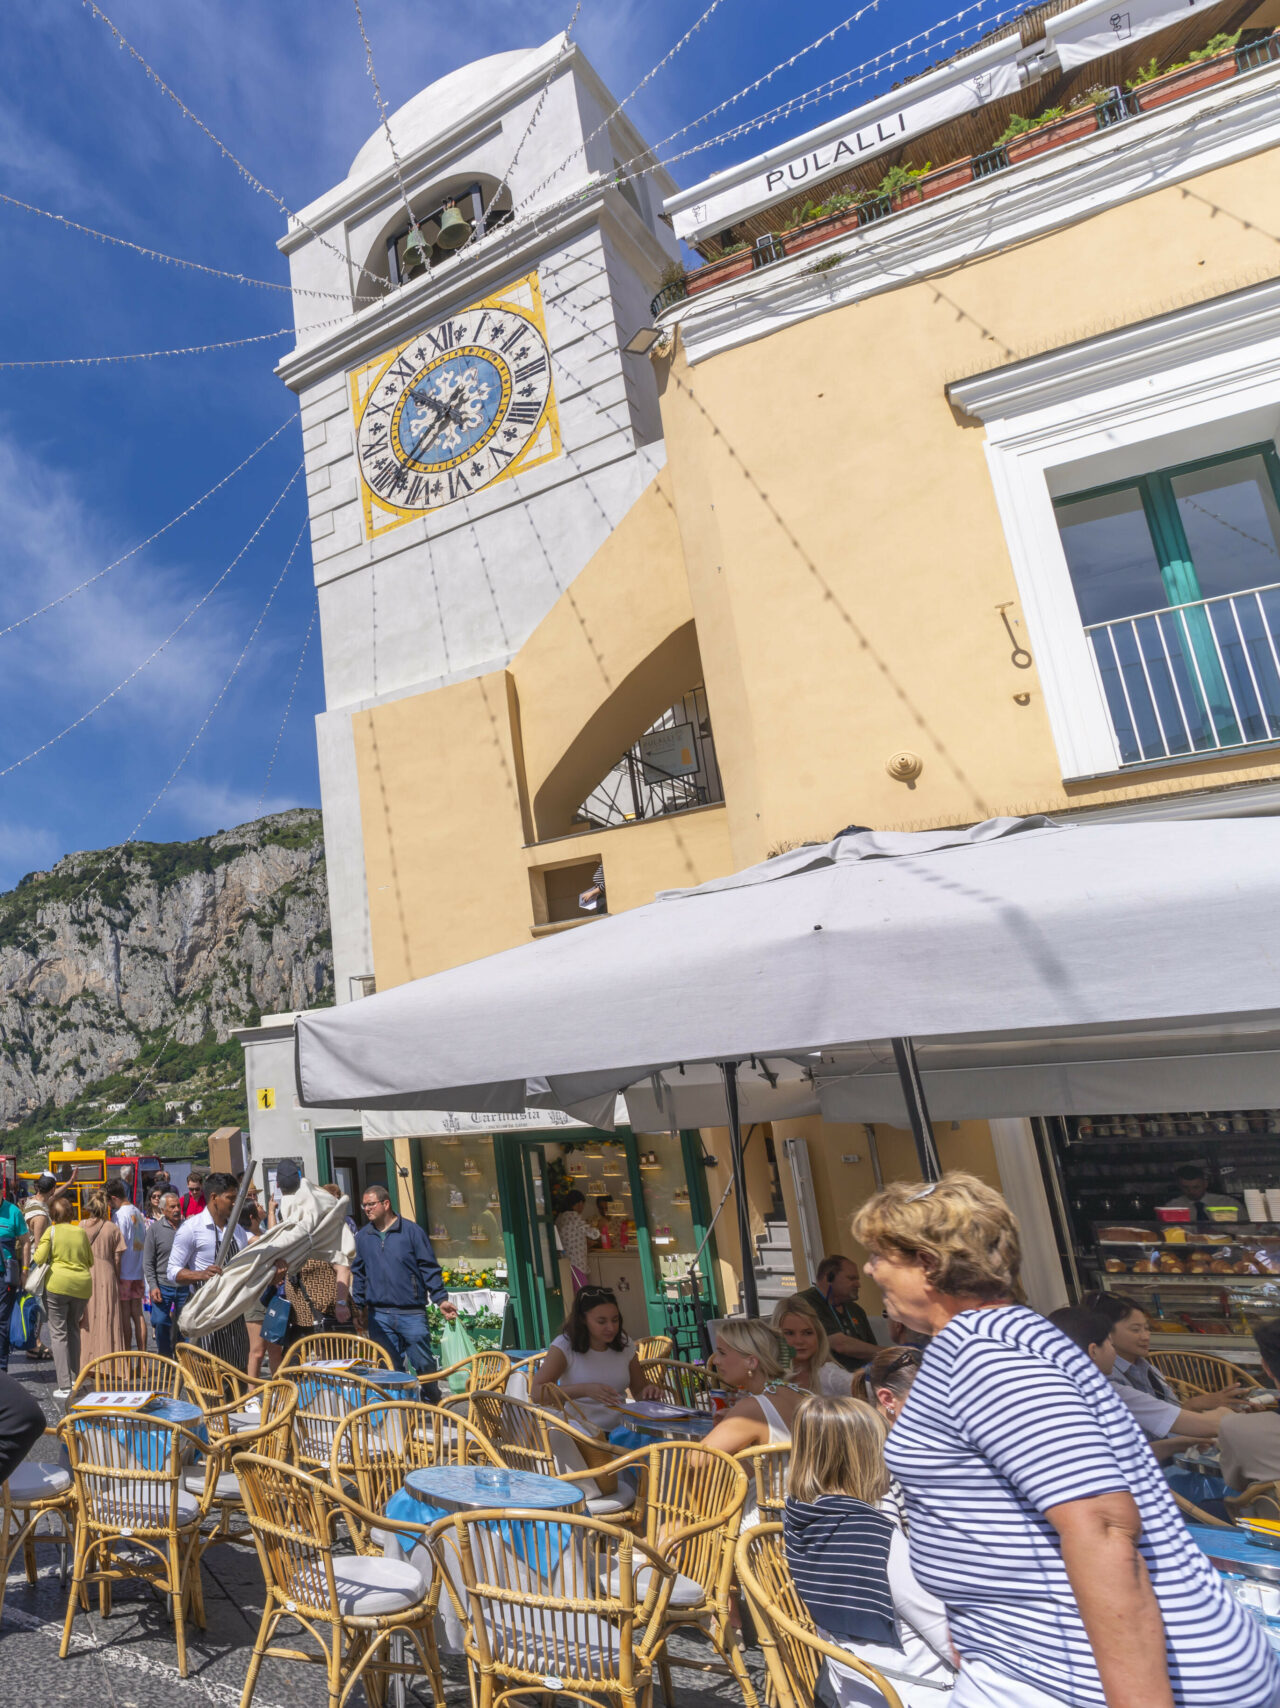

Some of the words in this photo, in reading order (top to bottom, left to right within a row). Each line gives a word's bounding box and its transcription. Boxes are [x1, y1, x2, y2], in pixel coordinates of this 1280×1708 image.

[765, 112, 906, 192] PULALLI
[426, 320, 455, 358] XII
[499, 323, 529, 354] II
[388, 356, 416, 387] XI
[514, 356, 547, 384] III
[365, 401, 395, 418] X
[488, 446, 515, 469] V
